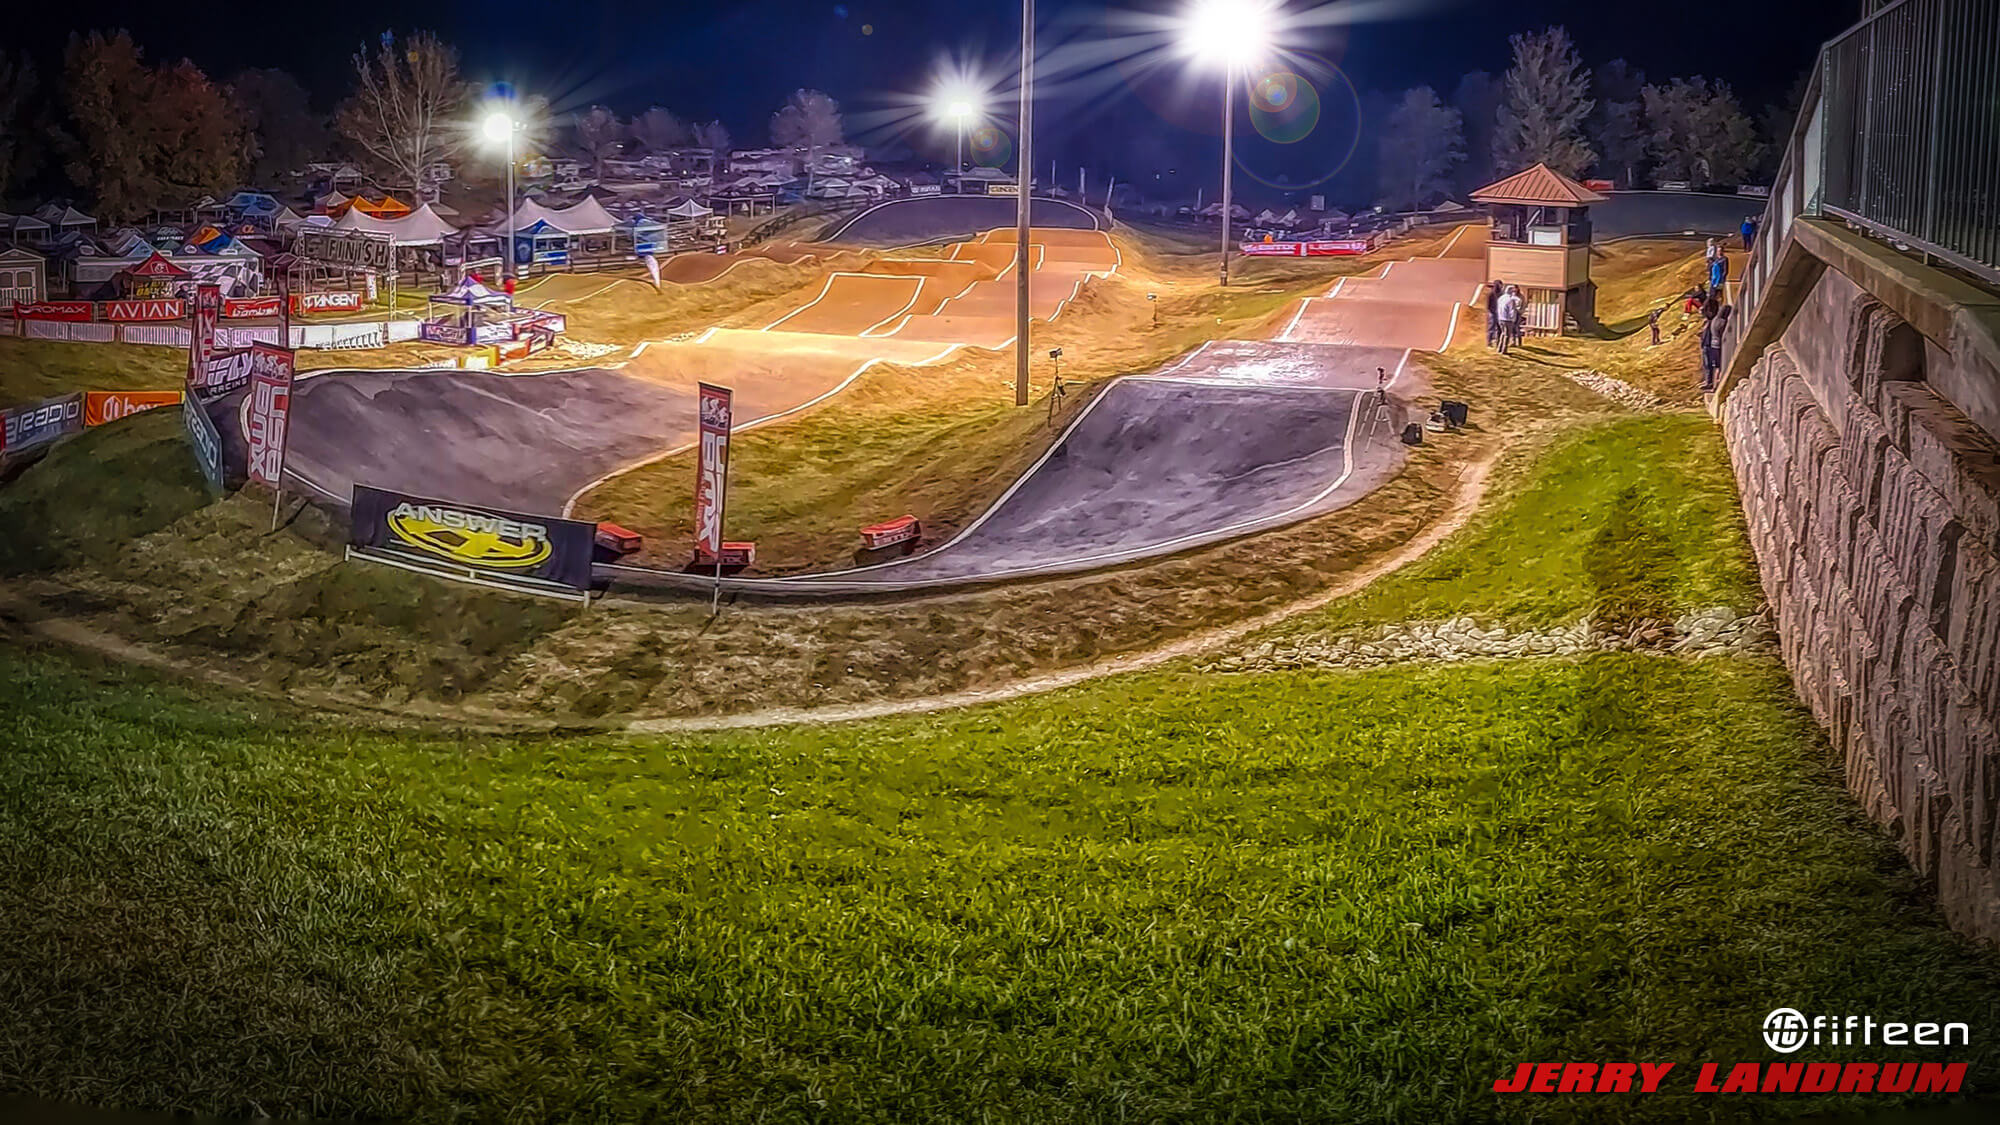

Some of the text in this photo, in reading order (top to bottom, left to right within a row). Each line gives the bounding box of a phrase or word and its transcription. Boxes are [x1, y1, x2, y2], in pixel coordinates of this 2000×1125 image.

[327, 239, 388, 266] FINISH
[111, 302, 180, 318] AVIAN
[312, 293, 360, 308] TANGENT
[209, 378, 248, 395] RACING
[251, 381, 270, 478] BMX
[265, 386, 288, 481] USA
[393, 502, 548, 542] ANSWER
